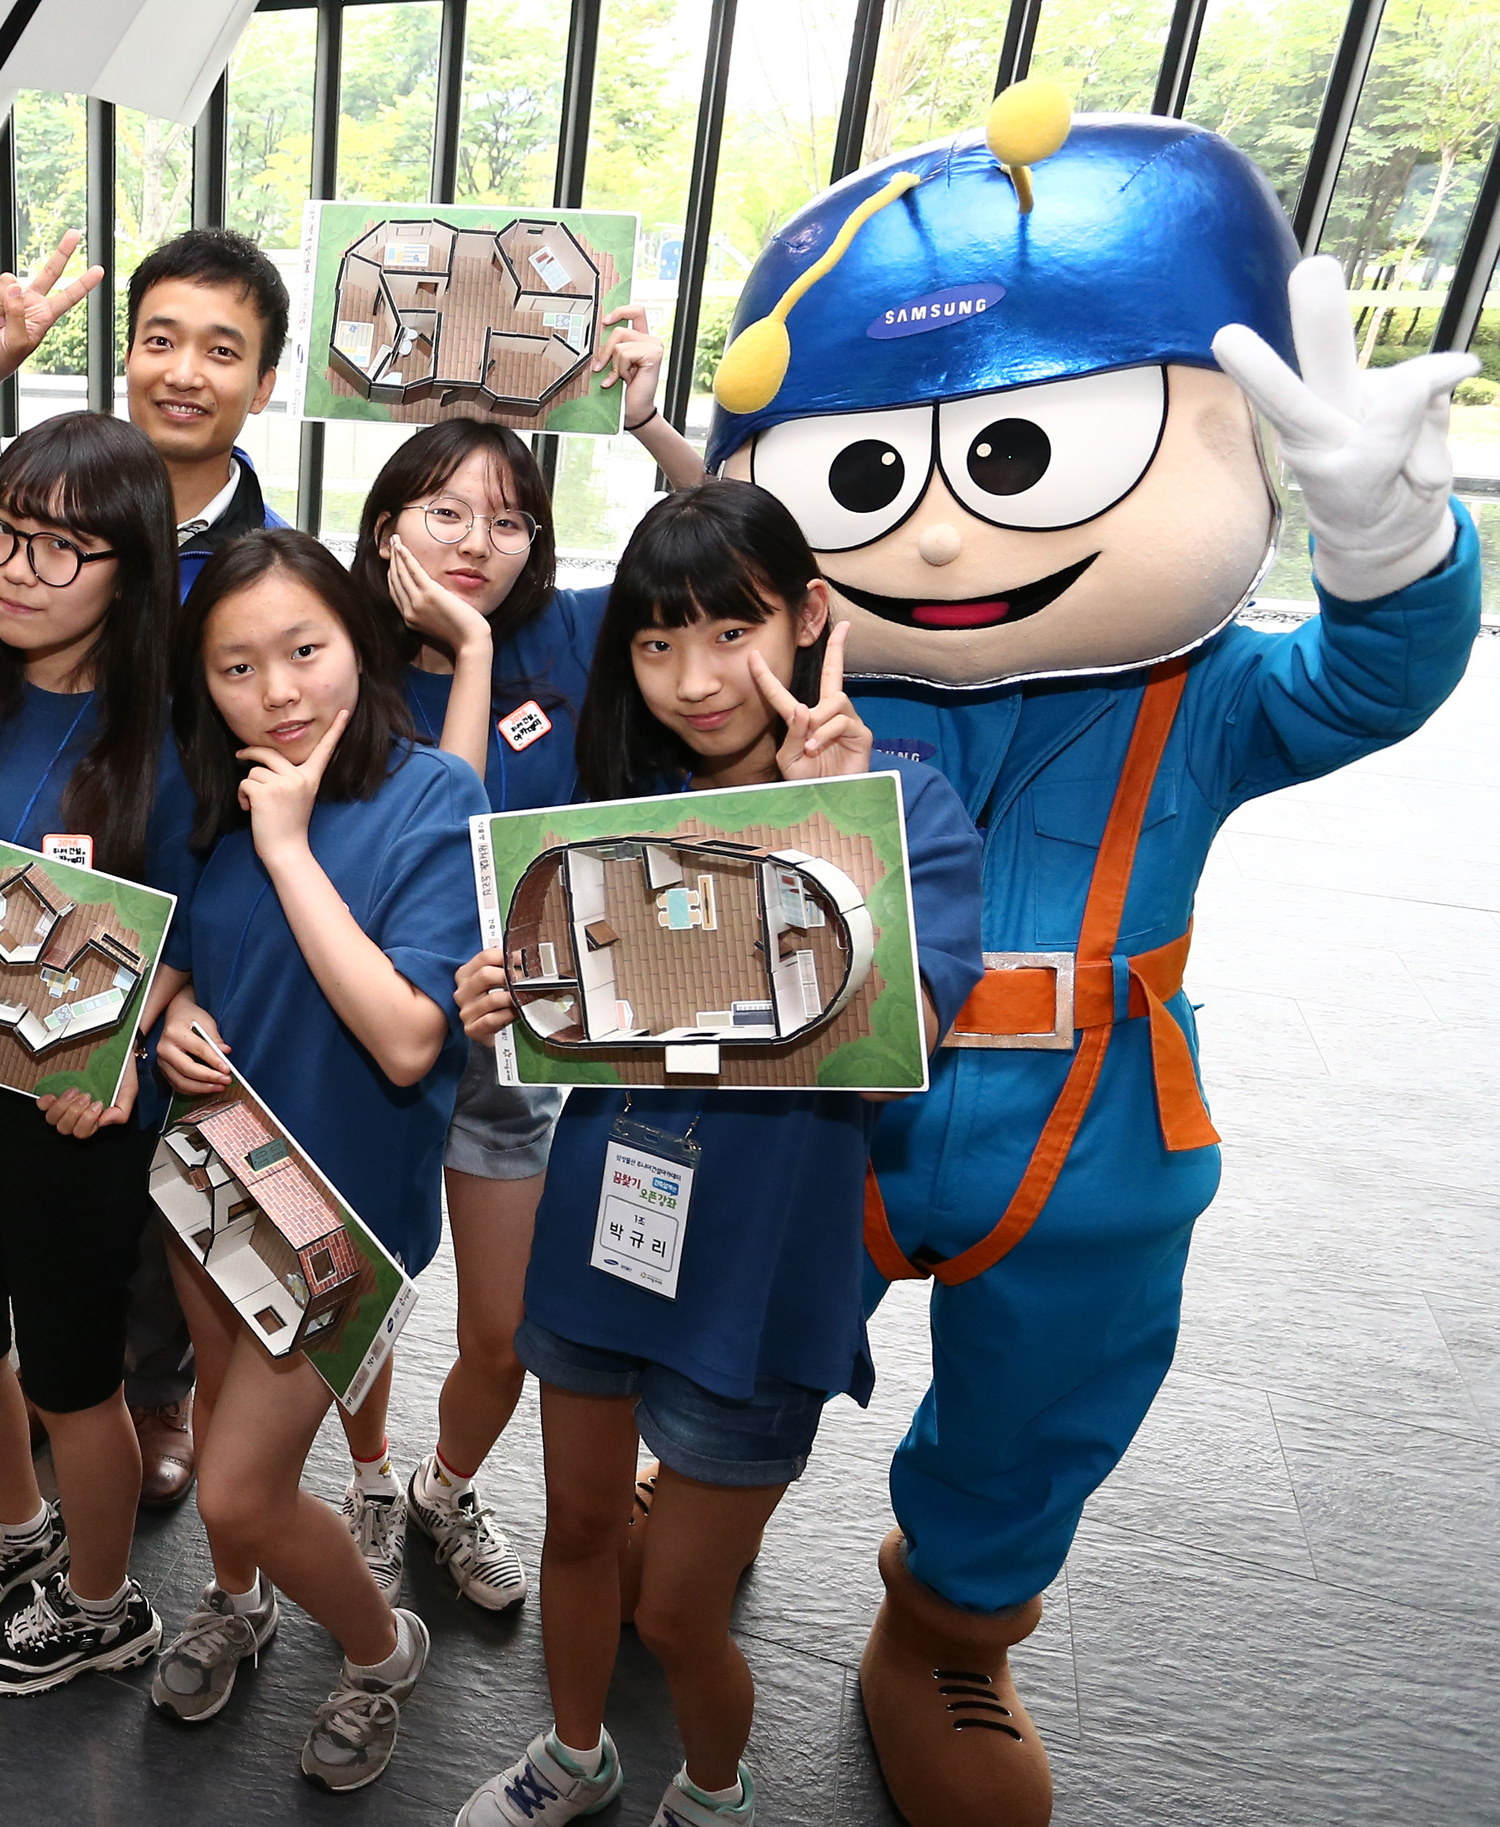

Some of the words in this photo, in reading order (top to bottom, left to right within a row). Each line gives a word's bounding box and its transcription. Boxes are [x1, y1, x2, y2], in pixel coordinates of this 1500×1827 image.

[884, 298, 988, 325] SAMSUNG
[57, 839, 79, 847] 2016
[613, 1170, 641, 1190] 꿈찾기
[638, 1188, 678, 1211] 오픈강좌
[633, 1214, 646, 1226] 1조
[609, 1221, 624, 1241] 박
[629, 1230, 645, 1249] 규
[651, 1238, 667, 1258] 리
